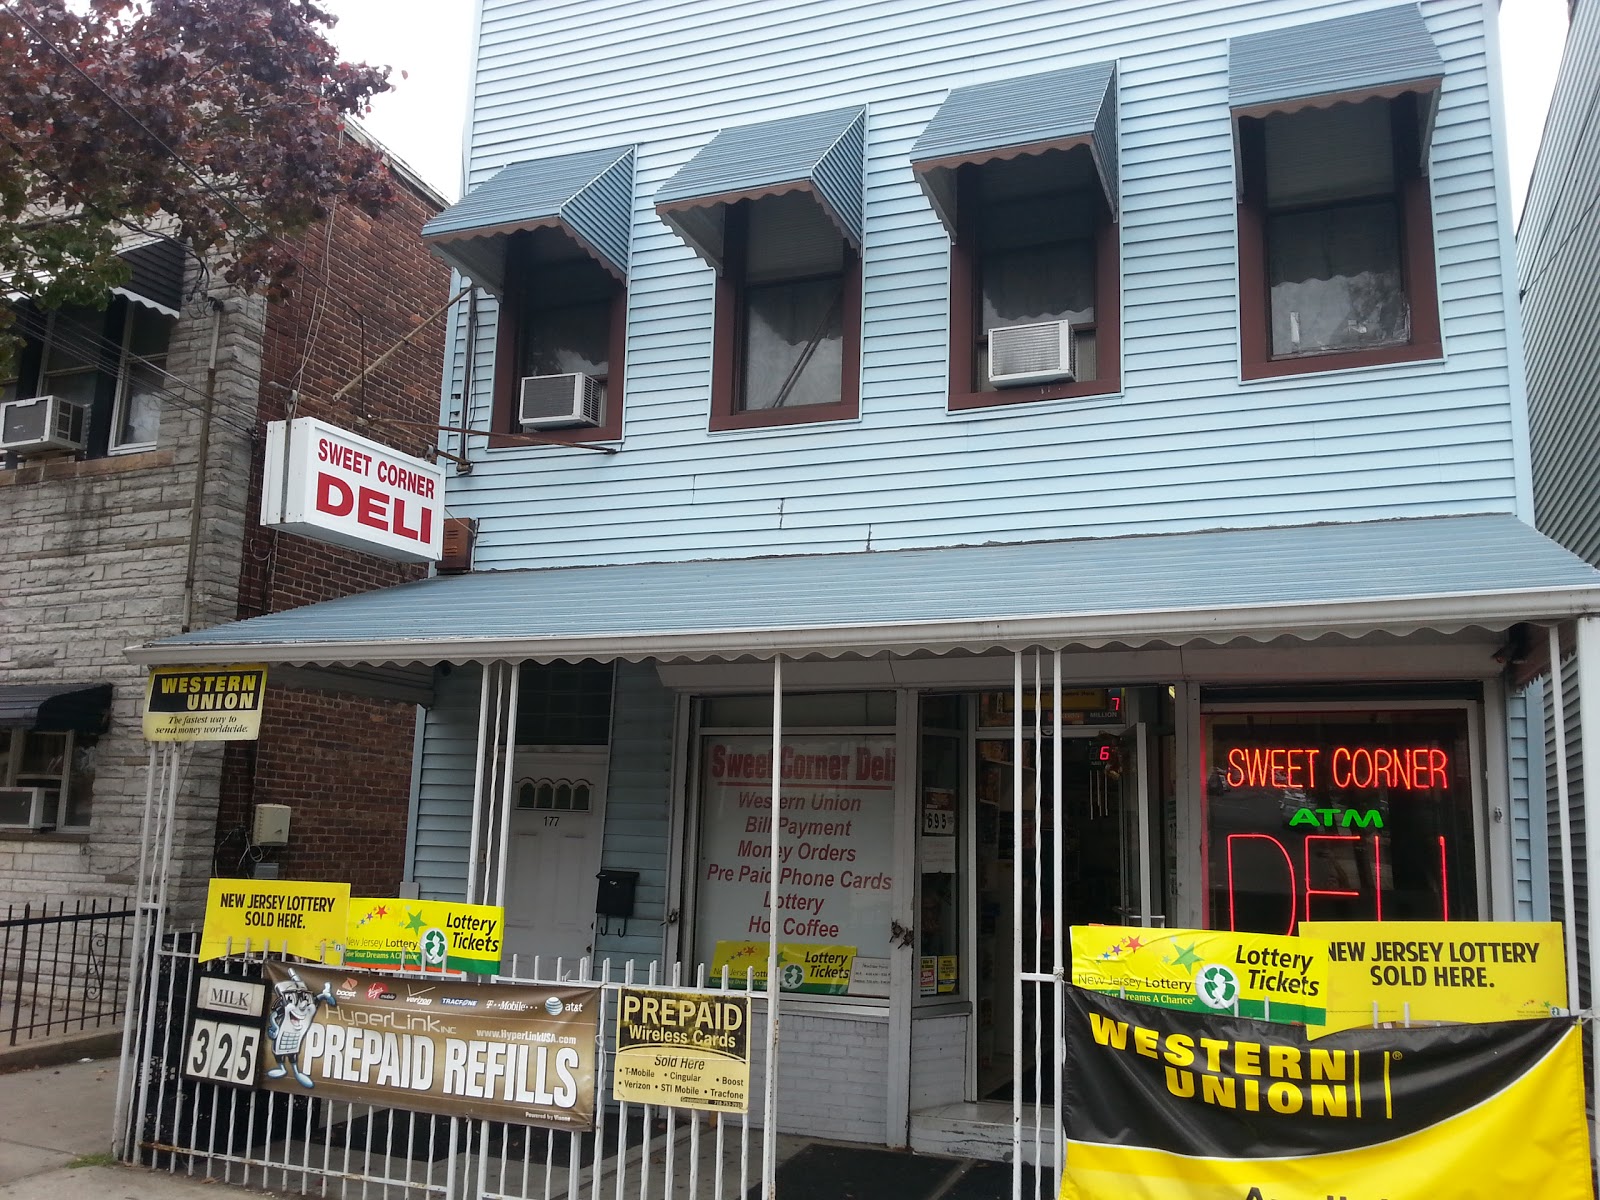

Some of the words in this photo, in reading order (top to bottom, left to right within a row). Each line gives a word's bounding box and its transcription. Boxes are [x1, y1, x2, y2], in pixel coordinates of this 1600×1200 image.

[318, 438, 372, 477] SWEET
[377, 460, 435, 499] CORNER
[316, 471, 432, 544] DELI
[161, 675, 256, 694] WESTERN
[186, 692, 254, 711] UNION
[1111, 697, 1120, 711] 7
[168, 716, 182, 725] The
[183, 715, 208, 726] fastest
[210, 716, 226, 725] way
[228, 715, 237, 723] to
[1089, 711, 1118, 719] MILLION
[155, 726, 176, 735] send
[178, 727, 202, 737] money
[1099, 745, 1110, 761] 6
[780, 746, 850, 781] Corner
[856, 747, 896, 782] Deli
[1227, 747, 1320, 789] SWEET
[1332, 746, 1448, 790] CORNER
[738, 791, 806, 811] Wesern
[811, 793, 862, 812] Union
[543, 815, 560, 828] 177
[744, 815, 774, 834] Bill
[1288, 807, 1384, 829] ATM
[797, 842, 857, 862] Orders
[706, 863, 735, 882] Pre
[779, 867, 835, 887] Phone
[840, 870, 892, 890] Cards
[220, 893, 245, 908] NEW
[247, 893, 285, 910] JERSEY
[286, 895, 336, 912] LOTTERY
[763, 890, 825, 916] Lottery
[245, 911, 275, 927] SOLD
[276, 912, 306, 929] HERE.
[446, 912, 497, 936] Lottery
[748, 915, 771, 934] Ho
[783, 917, 839, 938] Coffee
[360, 937, 383, 950] Jersey
[385, 938, 418, 950] Lottery
[452, 931, 500, 953] Tickets
[366, 951, 389, 959] Dreams
[805, 951, 849, 966] Lottery
[1235, 944, 1314, 975] Lottery
[1328, 941, 1366, 962] NEW
[1371, 941, 1443, 963] JERSEY
[1449, 942, 1540, 964] LOTTERY
[809, 964, 850, 979] Tickets
[1370, 965, 1427, 986] SOLD
[1433, 966, 1495, 988] HERE.
[336, 988, 357, 998] boost
[1078, 974, 1105, 986] New
[1106, 975, 1142, 990] Jersey
[1145, 976, 1192, 993] Lottery
[1248, 969, 1320, 997] Tickets
[210, 987, 250, 1007] MILK
[406, 996, 432, 1006] verizon
[564, 1001, 583, 1013] at&t
[1125, 994, 1151, 1003] reams
[1152, 994, 1159, 1003] A
[325, 1003, 441, 1033] HyperLink
[440, 1025, 457, 1035] INC
[623, 995, 743, 1032] PREPAID
[476, 1028, 577, 1045] www.HyperLinkUSA.com
[629, 1024, 688, 1044] Wireless
[693, 1029, 736, 1048] Cards
[193, 1028, 254, 1081] 325
[1088, 1012, 1347, 1082] WESTERN
[302, 1022, 436, 1091] PREPAID
[443, 1038, 579, 1109] REFILLS
[654, 1054, 678, 1069] Sold
[680, 1057, 705, 1071] Here
[624, 1066, 655, 1078] T-Mobile
[669, 1071, 701, 1083] Cingular
[721, 1076, 744, 1087] Boost
[624, 1080, 651, 1091] Verizon
[660, 1083, 673, 1093] STI
[674, 1085, 700, 1096] Mobile
[710, 1088, 744, 1100] Tracfone
[1165, 1065, 1348, 1119] UNION
